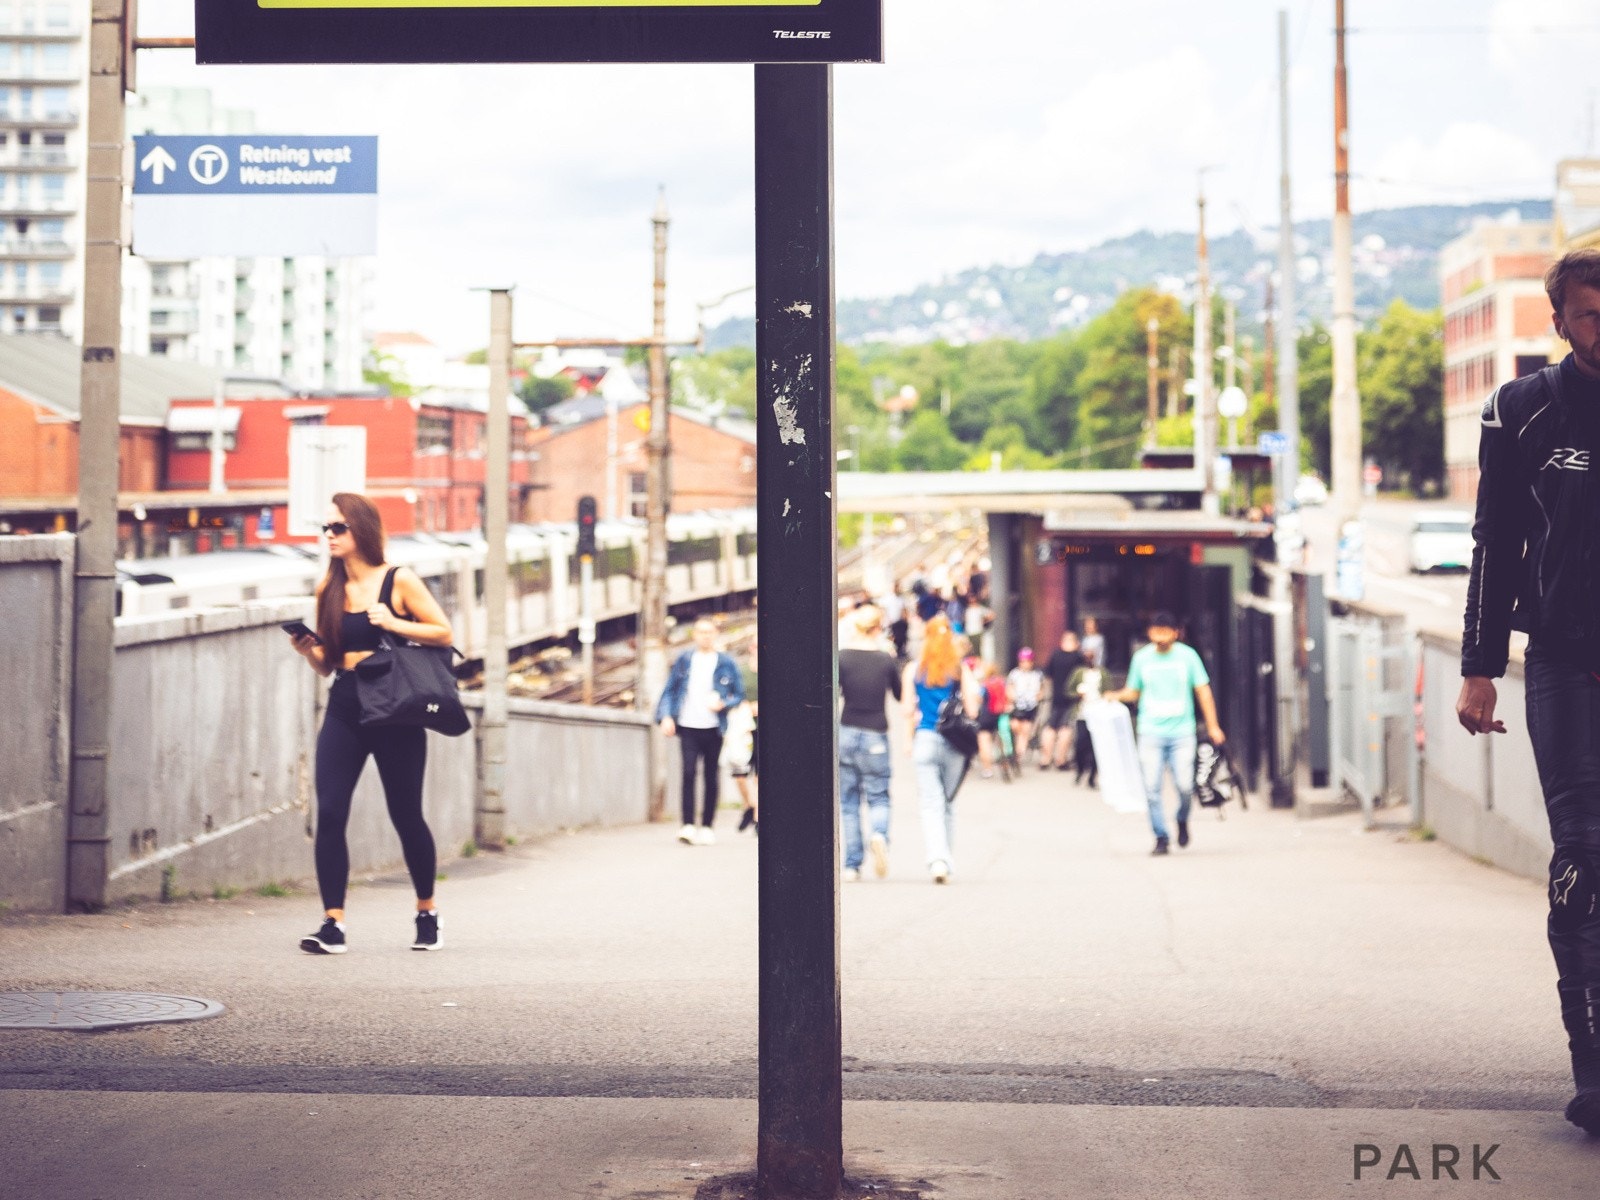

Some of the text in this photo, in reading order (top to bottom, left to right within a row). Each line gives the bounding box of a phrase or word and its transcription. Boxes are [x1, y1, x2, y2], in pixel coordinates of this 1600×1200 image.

[772, 29, 832, 39] TELESTE
[239, 144, 352, 167] Retning vest
[239, 166, 338, 185] Westbound
